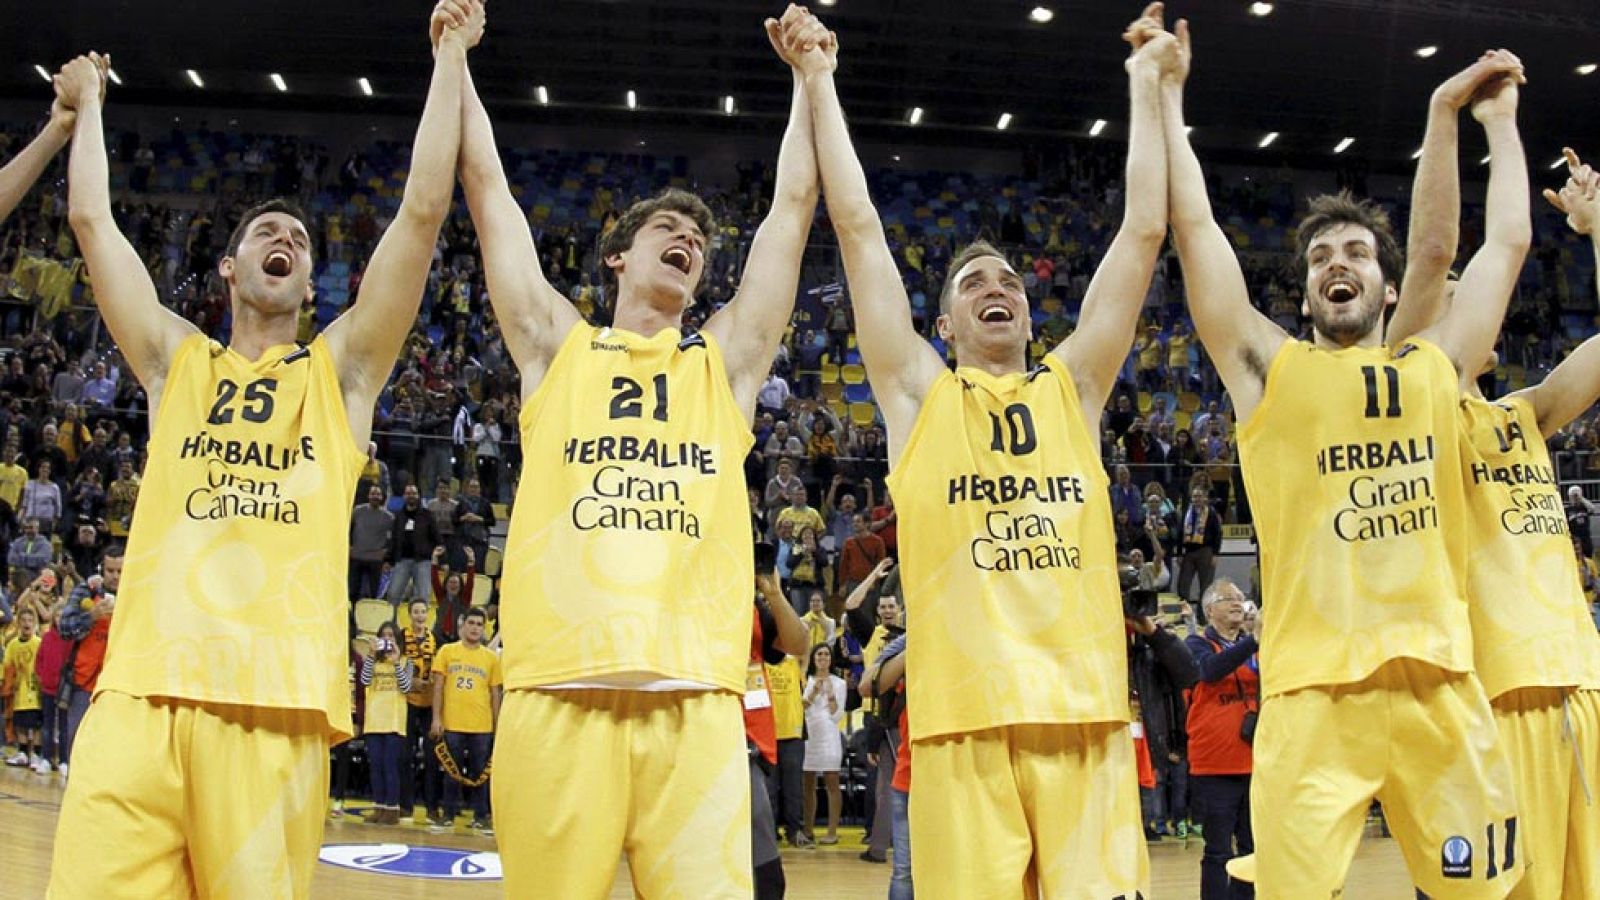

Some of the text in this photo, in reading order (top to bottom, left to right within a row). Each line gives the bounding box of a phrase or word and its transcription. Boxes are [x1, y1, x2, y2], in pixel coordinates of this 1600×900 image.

[207, 378, 278, 425] 25
[609, 374, 669, 422] 21
[1361, 365, 1403, 418] 11
[988, 403, 1037, 456] 10
[563, 436, 716, 475] HERBALIFE
[207, 459, 278, 497] Gran
[593, 465, 680, 502] Gran
[1349, 476, 1432, 510] Gran
[185, 488, 300, 524] Canaria
[572, 497, 701, 539] Canaria
[986, 510, 1059, 541] Gran
[971, 538, 1081, 572] Canaria
[456, 677, 474, 690] 25
[1486, 817, 1518, 880] 11
